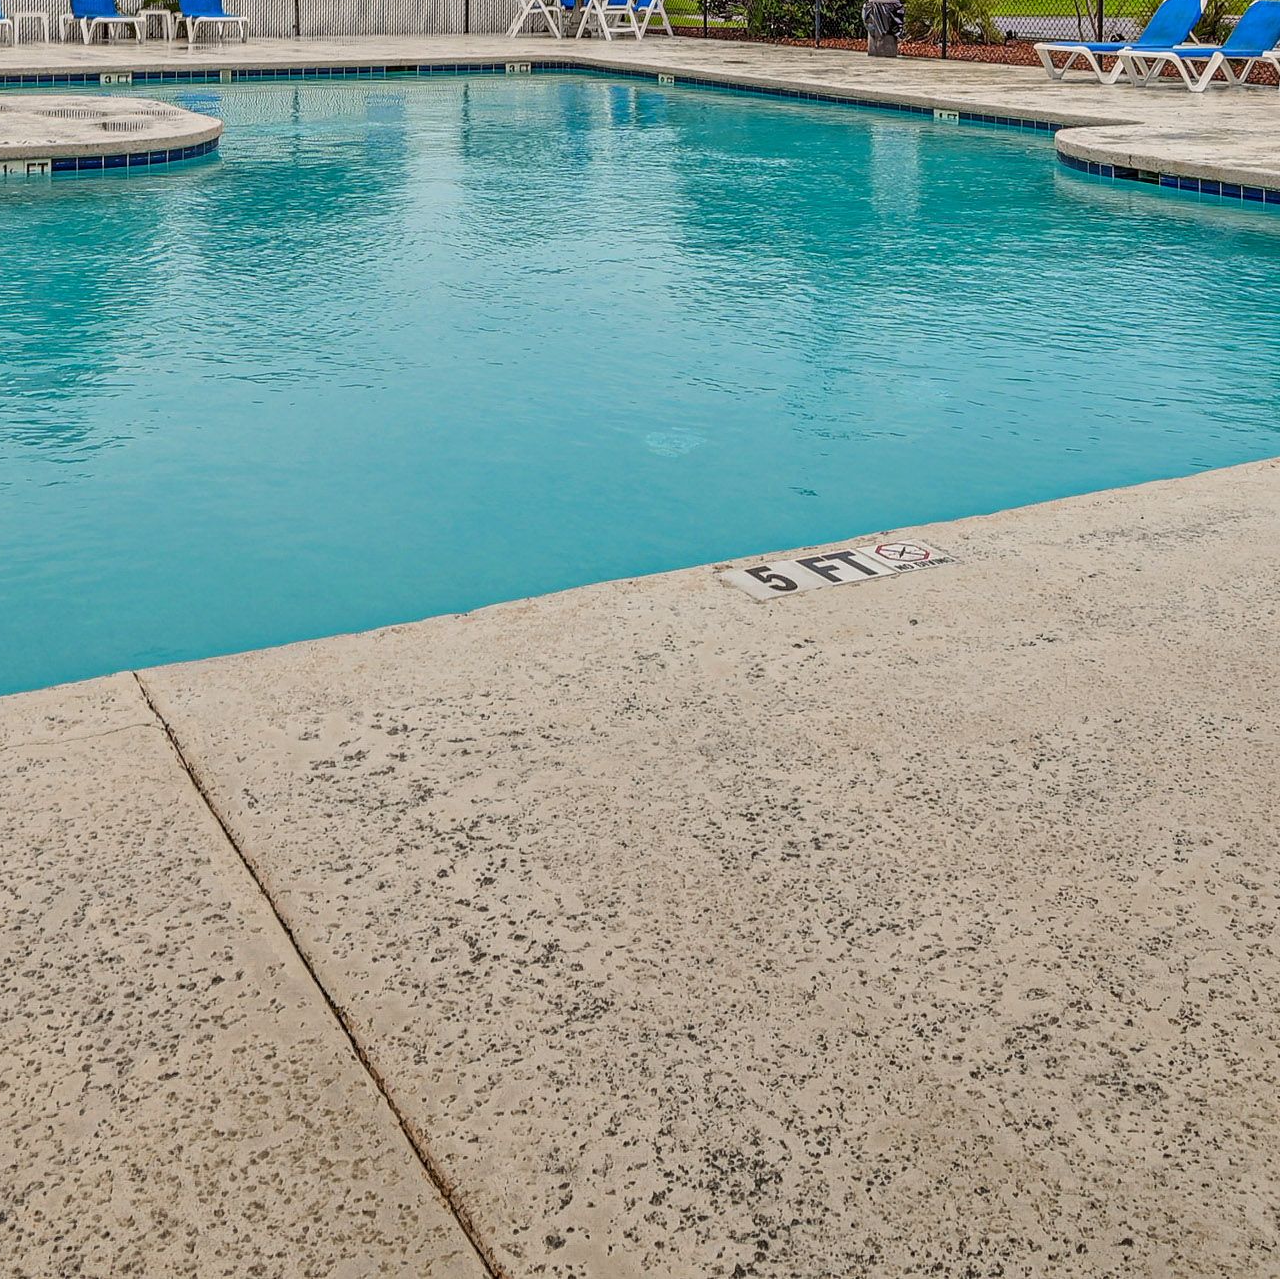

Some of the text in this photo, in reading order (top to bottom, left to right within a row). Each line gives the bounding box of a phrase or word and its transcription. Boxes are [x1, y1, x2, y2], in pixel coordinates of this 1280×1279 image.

[27, 162, 49, 177] FT
[913, 556, 956, 567] DIVING
[744, 550, 879, 591] 5 FT
